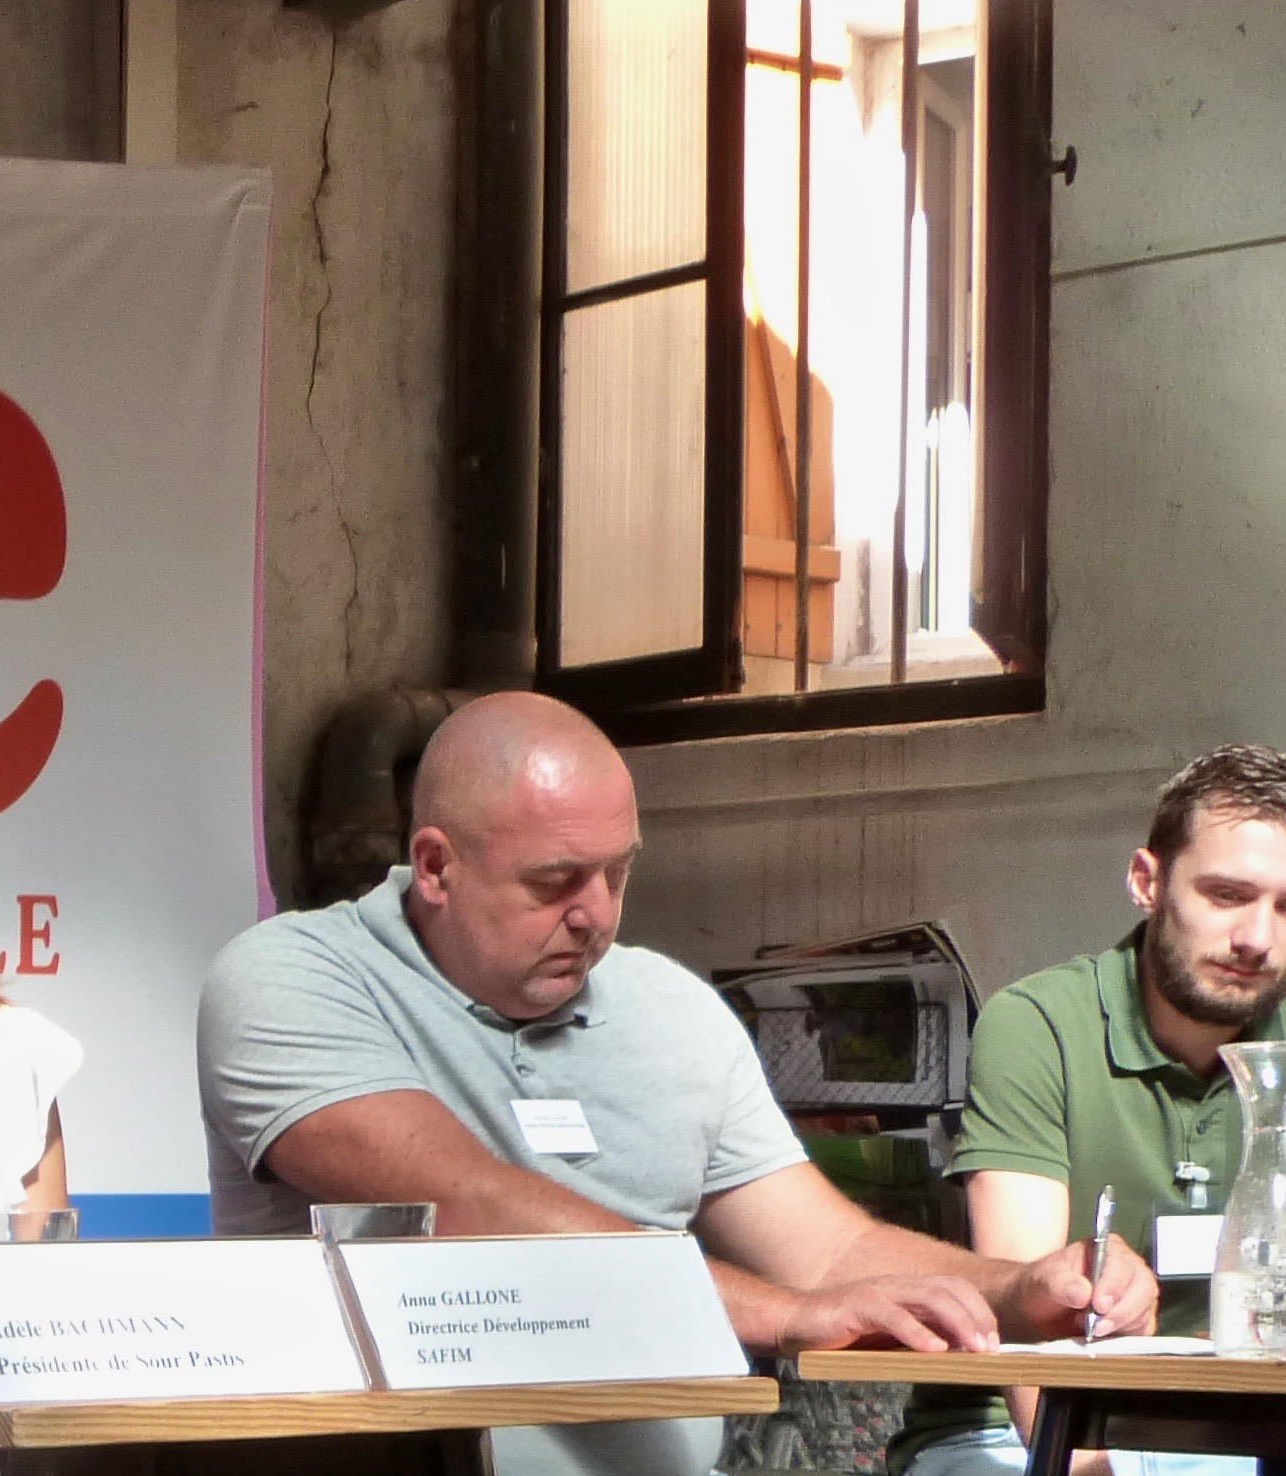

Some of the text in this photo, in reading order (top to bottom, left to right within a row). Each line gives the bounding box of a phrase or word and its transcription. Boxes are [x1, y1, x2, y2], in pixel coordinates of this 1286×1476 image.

[398, 1288, 522, 1308] Anna GALLONE
[408, 1315, 591, 1336] Directrice Développement
[108, 1353, 130, 1371] de
[416, 1346, 473, 1365] SAFIM
